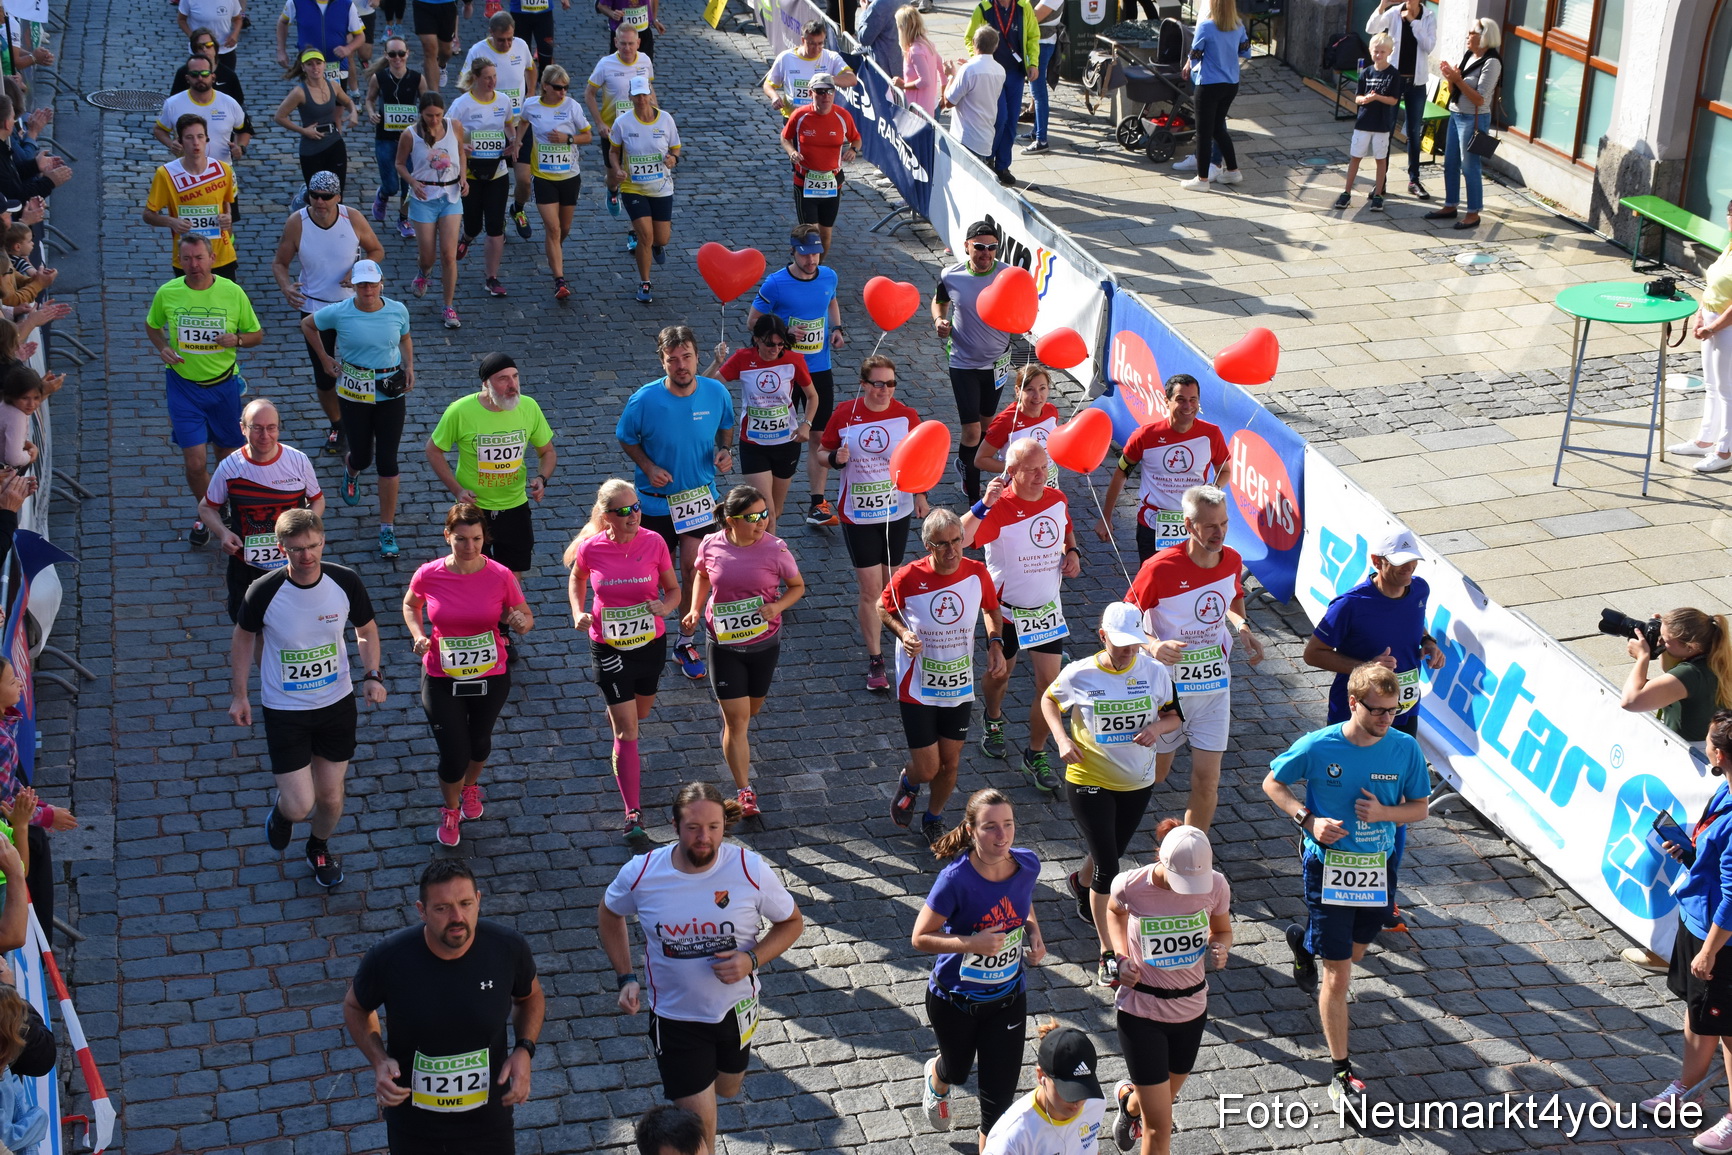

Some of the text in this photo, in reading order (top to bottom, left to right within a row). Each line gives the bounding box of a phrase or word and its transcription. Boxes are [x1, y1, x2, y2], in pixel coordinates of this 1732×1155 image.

[627, 15, 646, 25] 1017
[386, 105, 416, 113] BOCK
[388, 114, 415, 123] 1026
[474, 131, 502, 139] BOCK
[475, 141, 502, 150] 2098
[540, 144, 569, 152] BOCK
[542, 153, 568, 163] 2114
[631, 155, 660, 163] BOCK
[633, 163, 659, 175] 2121
[807, 171, 834, 179] BOCK
[808, 180, 834, 190] 2431
[179, 189, 203, 203] MAX
[181, 207, 216, 215] BOCK
[181, 317, 221, 328] BOCK
[184, 329, 220, 342] 1343
[184, 343, 219, 351] NORBERT
[343, 362, 373, 380] BOCK
[343, 376, 369, 392] 1041
[343, 389, 367, 400] MARGIT
[750, 406, 785, 418] BOCK
[752, 418, 786, 432] 2454
[481, 433, 521, 445] BOCK
[483, 445, 520, 461] 1207
[478, 475, 519, 488] REISEN
[854, 481, 891, 493] BOCK
[669, 486, 707, 504] BOCK
[676, 498, 711, 519] 2479
[1239, 495, 1265, 527] SPORTS
[685, 513, 710, 527] BERND
[1161, 524, 1189, 537] 230
[250, 548, 287, 562] 232
[259, 561, 285, 570] RANK
[605, 606, 649, 620] BOCK
[716, 600, 759, 614] BOCK
[609, 619, 650, 637] 1274
[720, 613, 762, 631] 1266
[1020, 613, 1058, 633] 2457
[731, 630, 756, 639] AIGUL
[1028, 631, 1059, 642] JÜRGEN
[1180, 628, 1206, 636] LAUFEN
[444, 634, 490, 649] BOCK
[614, 636, 647, 646] MARION
[284, 645, 333, 662] BOCK
[448, 649, 492, 667] 1273
[287, 659, 332, 680] 2491
[926, 655, 970, 673] BOCK
[462, 667, 480, 675] EVA
[1180, 662, 1222, 681] 2456
[296, 679, 329, 690] DANIEL
[927, 671, 969, 688] 2455
[1126, 678, 1137, 686] 20
[1183, 680, 1222, 692] RÜDIGER
[934, 689, 962, 697] JOSEF
[1098, 698, 1149, 714] BOCK
[1101, 713, 1148, 732] 2657
[1370, 773, 1398, 781] BOCK
[1329, 854, 1381, 867] BOCK
[1330, 869, 1379, 888] 2022
[1334, 890, 1375, 900] NATHAN
[654, 917, 735, 938] twinn
[1144, 914, 1205, 934] BOCK
[1149, 931, 1204, 956] 2096
[970, 946, 1018, 969] 2089
[1155, 952, 1201, 967] MELANIE
[982, 971, 1005, 979] LISA
[418, 1052, 483, 1072] BOCK
[1072, 1069, 1092, 1077] adidas
[421, 1072, 481, 1094] 1212
[436, 1097, 464, 1106] UWE
